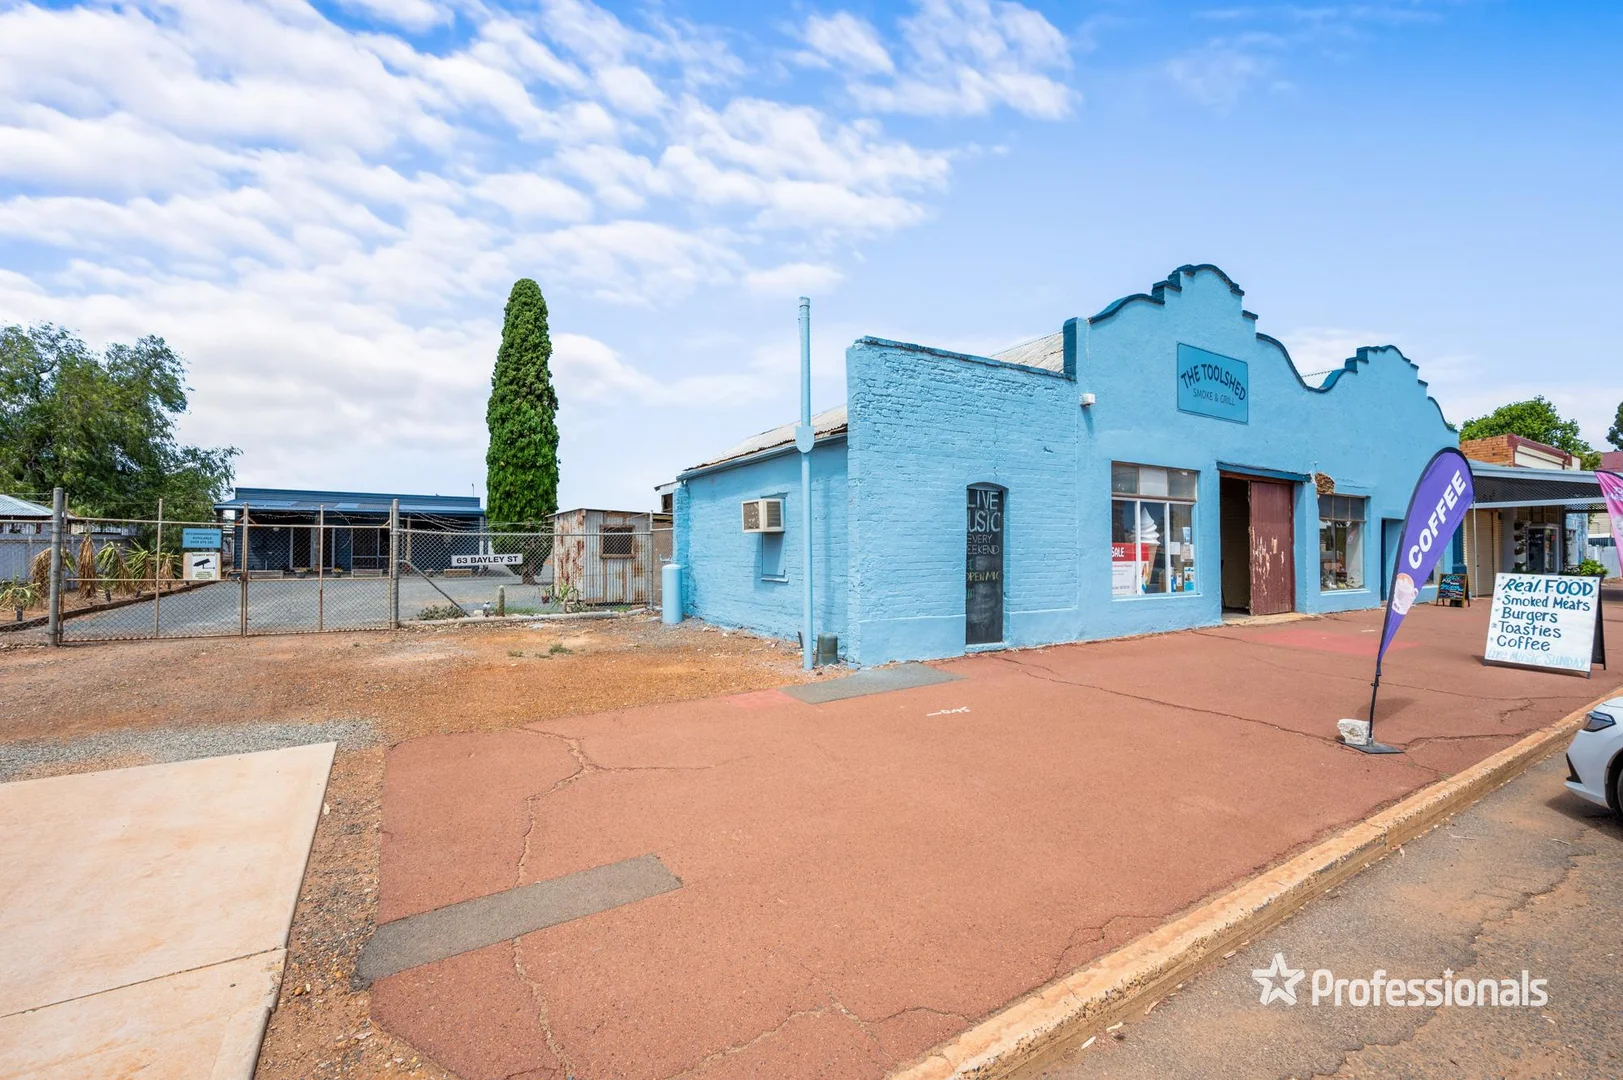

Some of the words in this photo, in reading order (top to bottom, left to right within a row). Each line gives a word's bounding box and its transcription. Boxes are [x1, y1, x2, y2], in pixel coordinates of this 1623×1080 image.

[1181, 365, 1200, 389] THE
[1201, 363, 1246, 401] TOOLSHED
[1193, 388, 1213, 401] SMOKE
[1215, 393, 1219, 402] &
[1220, 394, 1236, 407] GRILL
[967, 509, 1001, 533] USIC
[1408, 470, 1467, 570] COFFEE
[967, 543, 1000, 555] EEKEND
[1111, 547, 1125, 558] SALE
[470, 556, 505, 564] BAYLEY
[1502, 578, 1541, 593] Real
[1544, 579, 1594, 597] FOOD
[1502, 594, 1549, 608] Smoked
[1552, 597, 1591, 612] Meats
[1501, 606, 1558, 626] Burgers
[1498, 620, 1562, 639] Toasties
[1496, 634, 1551, 652] Coffee
[1544, 652, 1586, 669] SUNDAY
